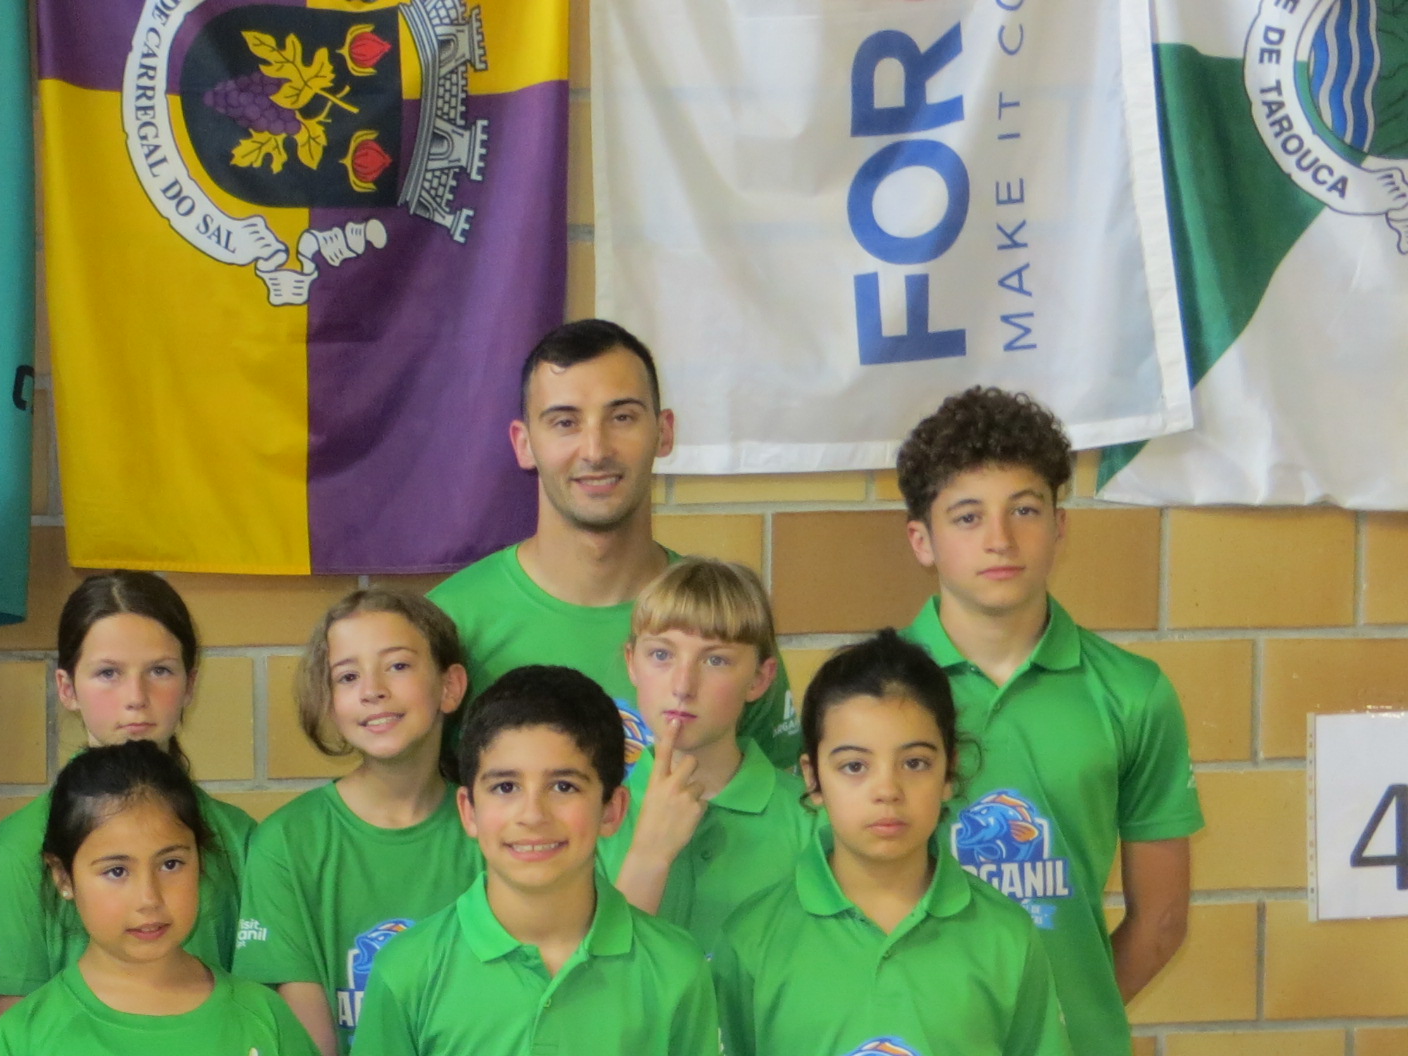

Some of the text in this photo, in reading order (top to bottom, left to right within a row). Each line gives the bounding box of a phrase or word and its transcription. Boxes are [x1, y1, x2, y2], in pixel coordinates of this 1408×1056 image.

[998, 92, 1025, 141] IT
[1258, 25, 1286, 65] DE
[135, 27, 169, 177] CARREGAL
[161, 178, 196, 217] DO
[196, 214, 237, 254] SAL
[847, 21, 970, 366] FOR
[1259, 79, 1349, 200] TAROUCA
[996, 177, 1037, 353] MAKE
